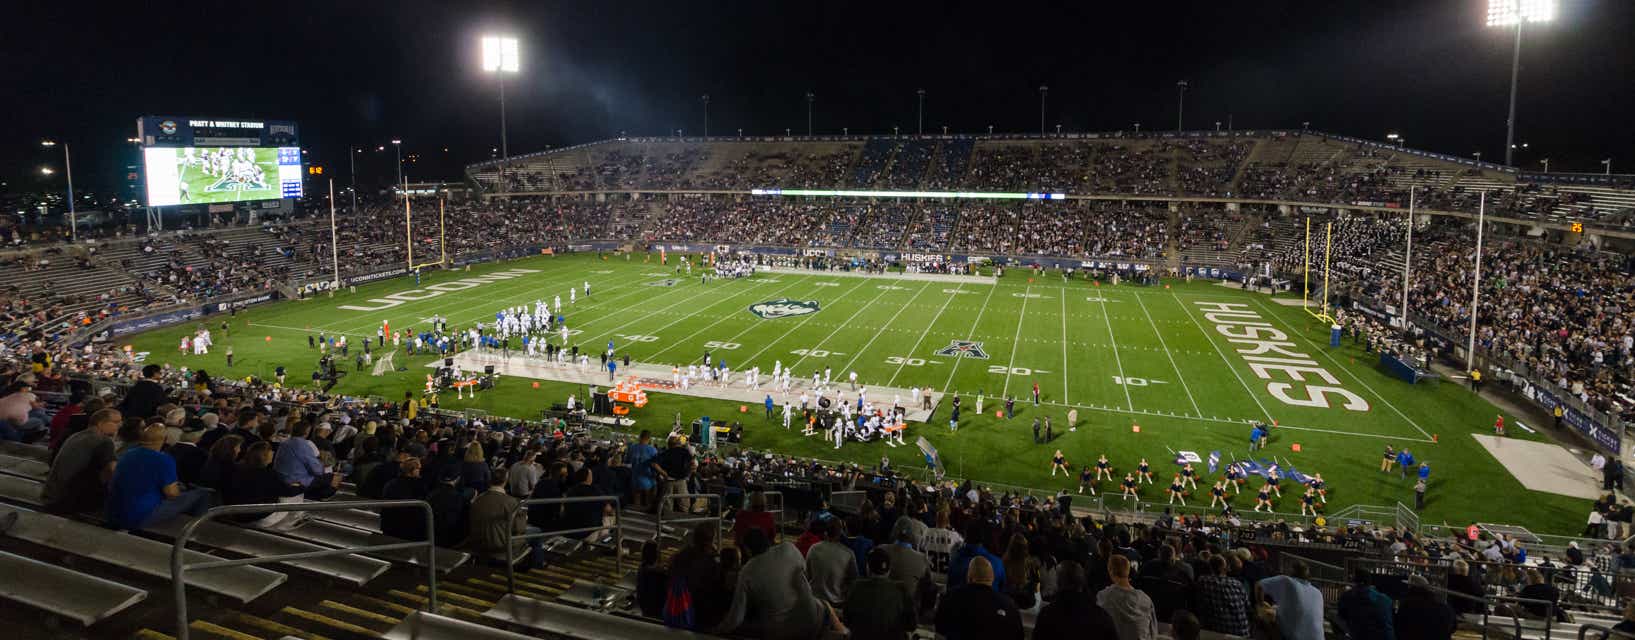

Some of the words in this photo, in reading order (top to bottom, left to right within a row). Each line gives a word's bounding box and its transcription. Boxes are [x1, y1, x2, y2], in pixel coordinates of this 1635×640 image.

[1572, 223, 1582, 232] 25
[901, 253, 944, 263] HUSKIES
[336, 269, 544, 312] UCONN
[624, 335, 660, 343] 40
[703, 340, 742, 350] 50
[790, 349, 831, 358] 40
[1194, 301, 1372, 412] HUSKIES
[885, 356, 926, 366] 30
[987, 365, 1032, 376] 20
[1112, 375, 1149, 387] 10
[928, 551, 950, 574] 32
